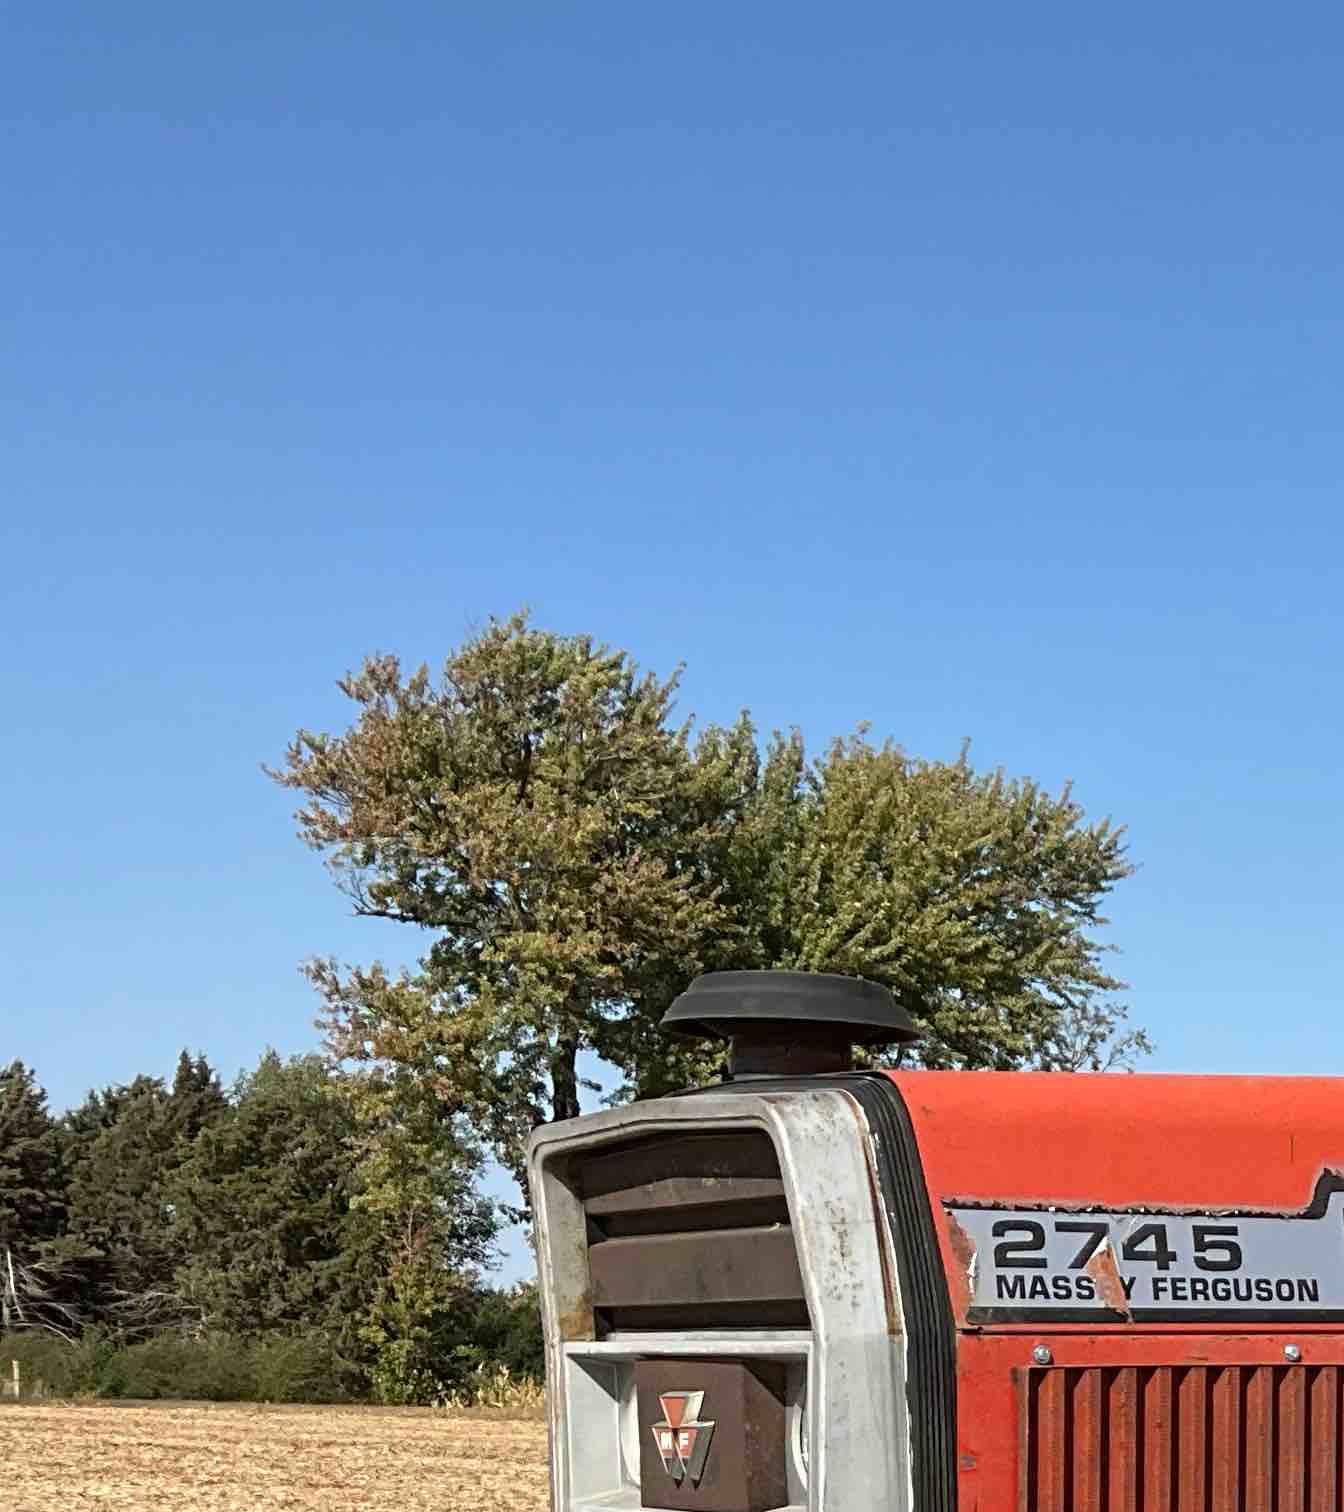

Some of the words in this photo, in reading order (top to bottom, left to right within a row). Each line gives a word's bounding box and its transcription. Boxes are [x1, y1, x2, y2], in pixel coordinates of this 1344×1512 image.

[991, 1219, 1244, 1272] 2745
[996, 1274, 1137, 1301] MASSY
[1152, 1276, 1320, 1302] FERGUSON
